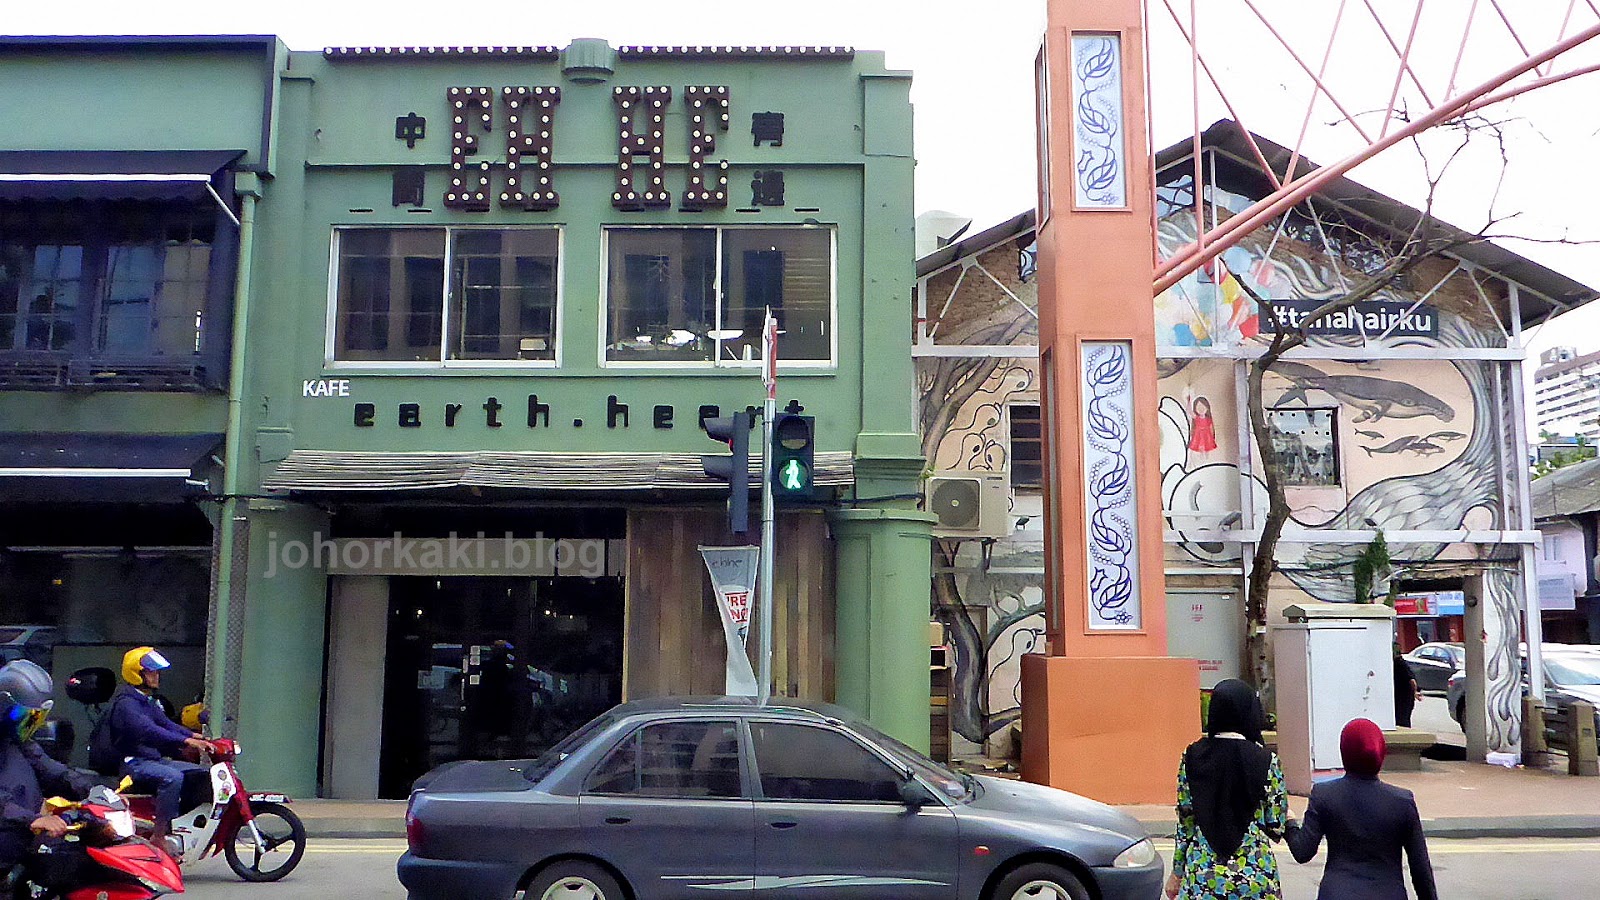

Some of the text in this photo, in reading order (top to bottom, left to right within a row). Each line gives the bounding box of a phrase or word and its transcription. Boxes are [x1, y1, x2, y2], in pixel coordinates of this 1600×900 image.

[444, 85, 729, 208] EH HE
[302, 379, 350, 397] KAFE
